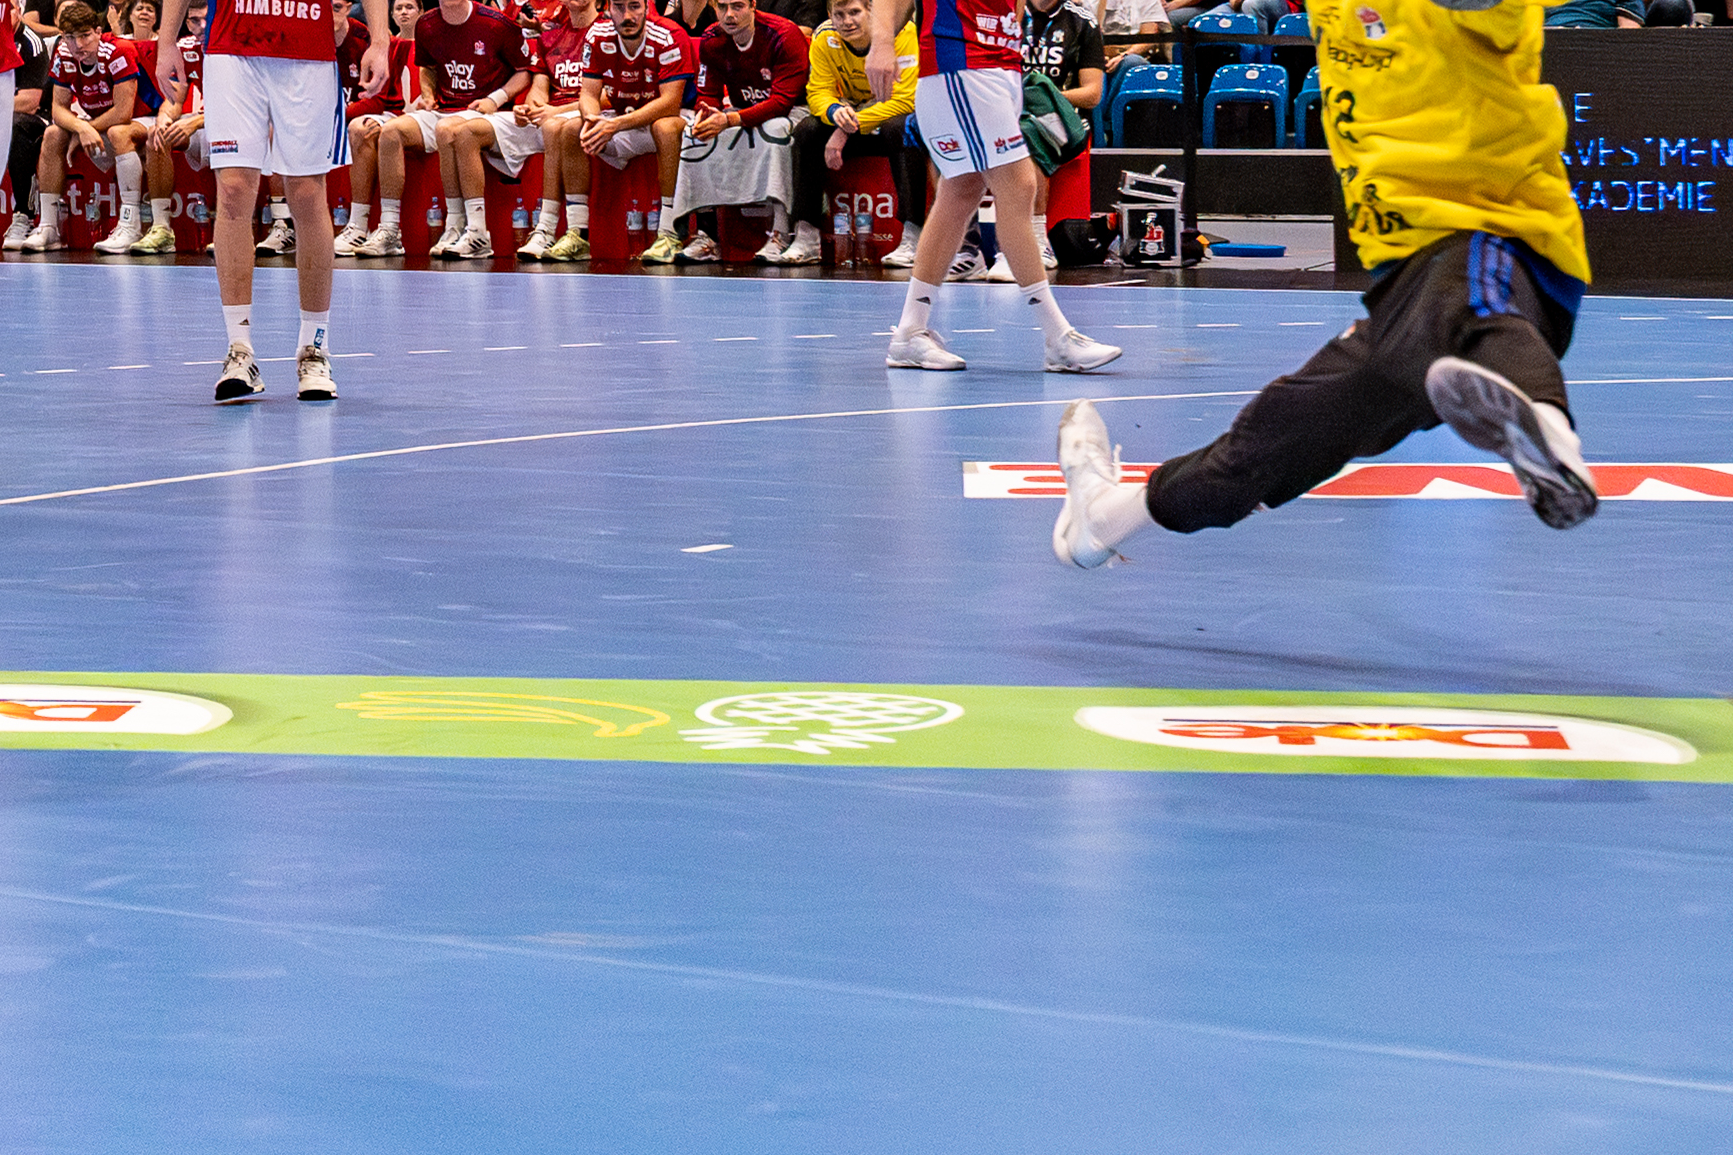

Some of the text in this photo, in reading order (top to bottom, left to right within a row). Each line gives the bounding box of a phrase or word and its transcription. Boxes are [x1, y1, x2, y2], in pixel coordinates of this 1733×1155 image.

[1022, 45, 1064, 65] ANS
[444, 60, 474, 83] play
[451, 75, 476, 90] itas
